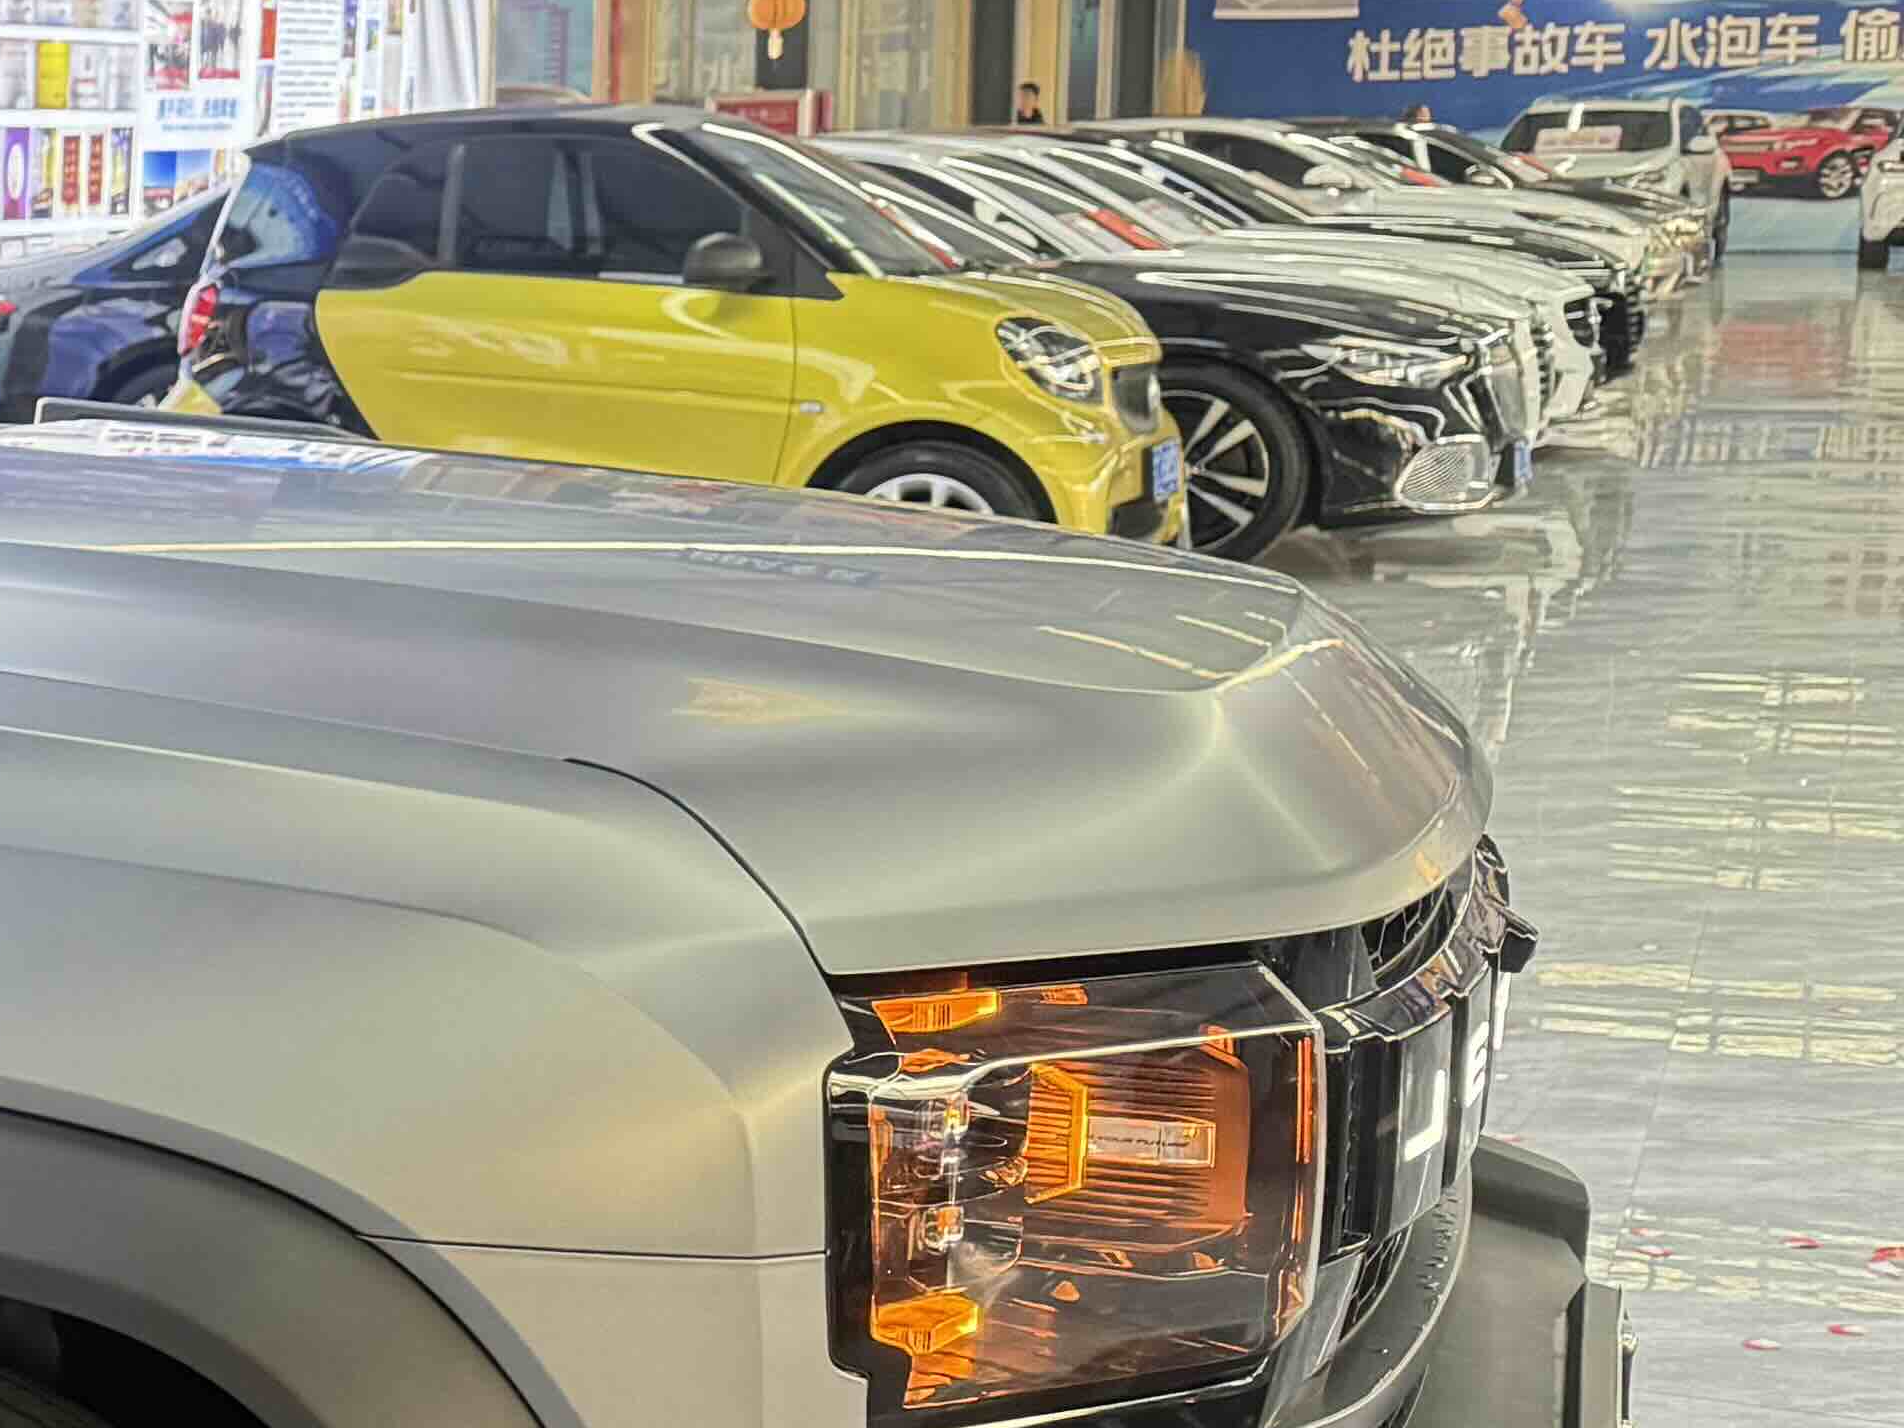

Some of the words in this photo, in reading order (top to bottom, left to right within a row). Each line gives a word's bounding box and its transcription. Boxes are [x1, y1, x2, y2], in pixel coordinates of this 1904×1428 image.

[1345, 19, 1627, 84] 杜绝事故车
[1644, 10, 1822, 70] 水泡车
